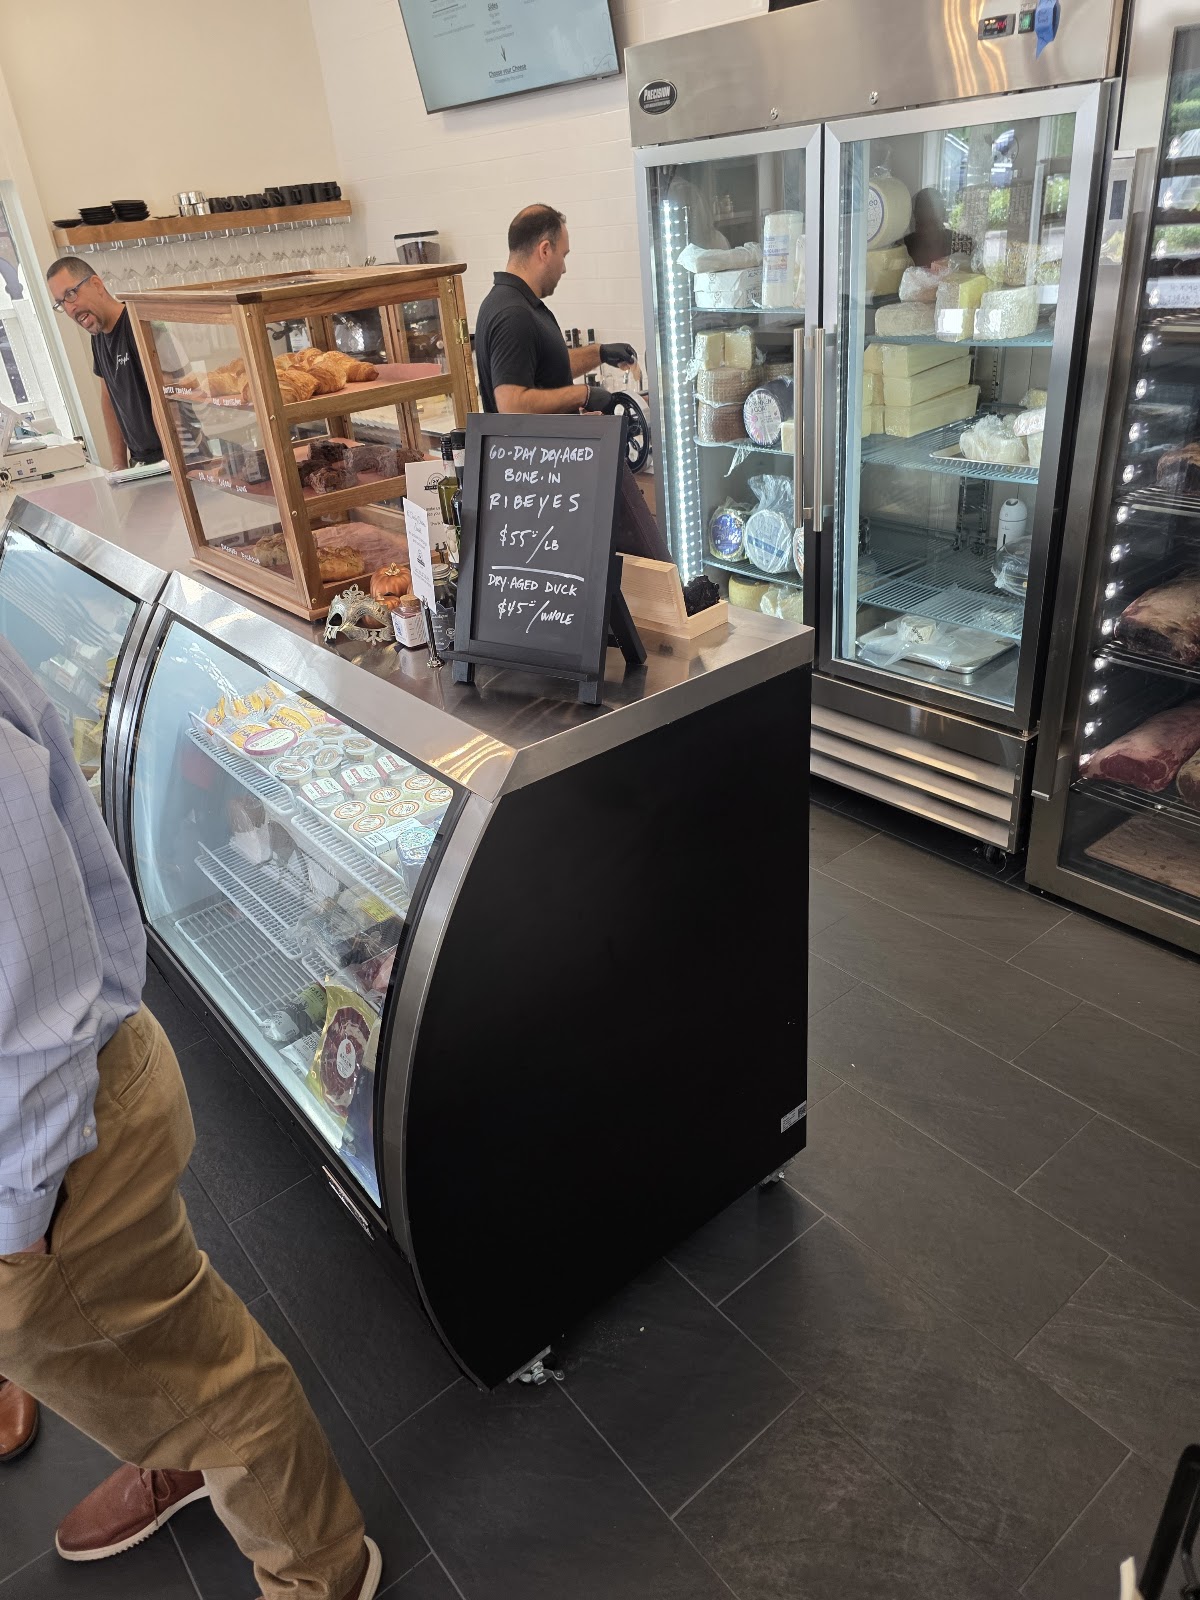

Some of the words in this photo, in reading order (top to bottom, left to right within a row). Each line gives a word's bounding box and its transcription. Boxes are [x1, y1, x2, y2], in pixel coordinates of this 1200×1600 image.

[643, 85, 671, 102] PRECISION
[489, 444, 537, 466] 60-DAY
[489, 493, 581, 519] RIBEYES
[544, 581, 578, 597] DUCK
